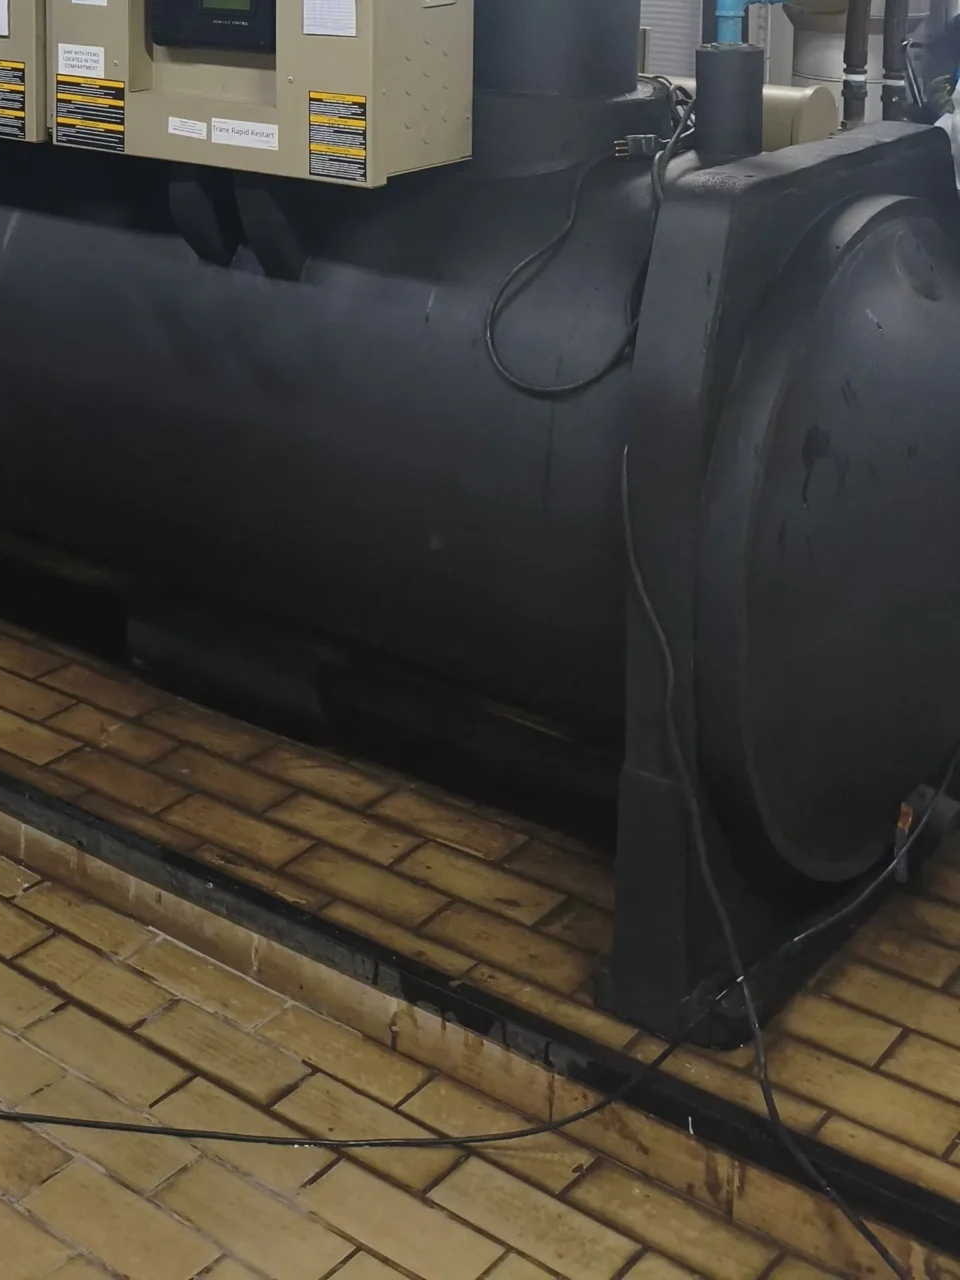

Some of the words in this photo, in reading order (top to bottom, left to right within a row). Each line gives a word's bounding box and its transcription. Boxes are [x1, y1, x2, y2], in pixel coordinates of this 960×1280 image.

[212, 125, 230, 134] Trane
[231, 127, 250, 137] Rapid
[250, 129, 275, 139] Restart
